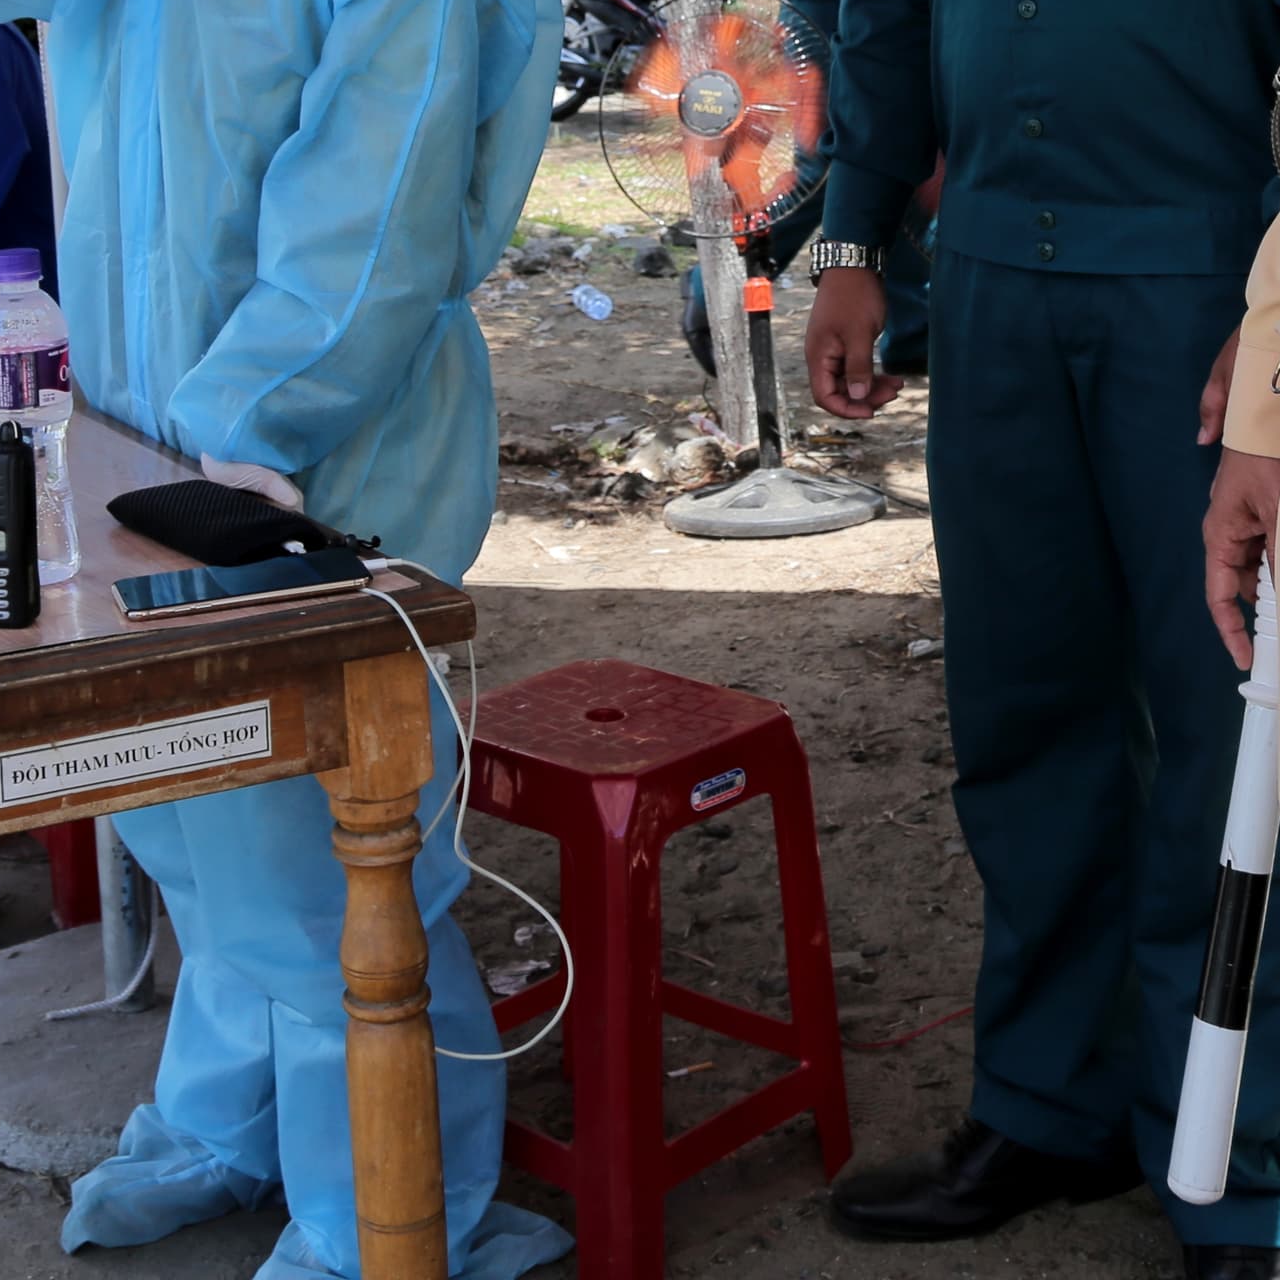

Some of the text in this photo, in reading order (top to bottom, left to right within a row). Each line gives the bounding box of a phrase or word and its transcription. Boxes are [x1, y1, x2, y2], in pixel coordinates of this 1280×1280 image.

[11, 763, 47, 785] ĐỘI
[51, 753, 109, 777] THAM
[166, 730, 218, 756] TỔNG
[222, 724, 260, 745] HỢP
